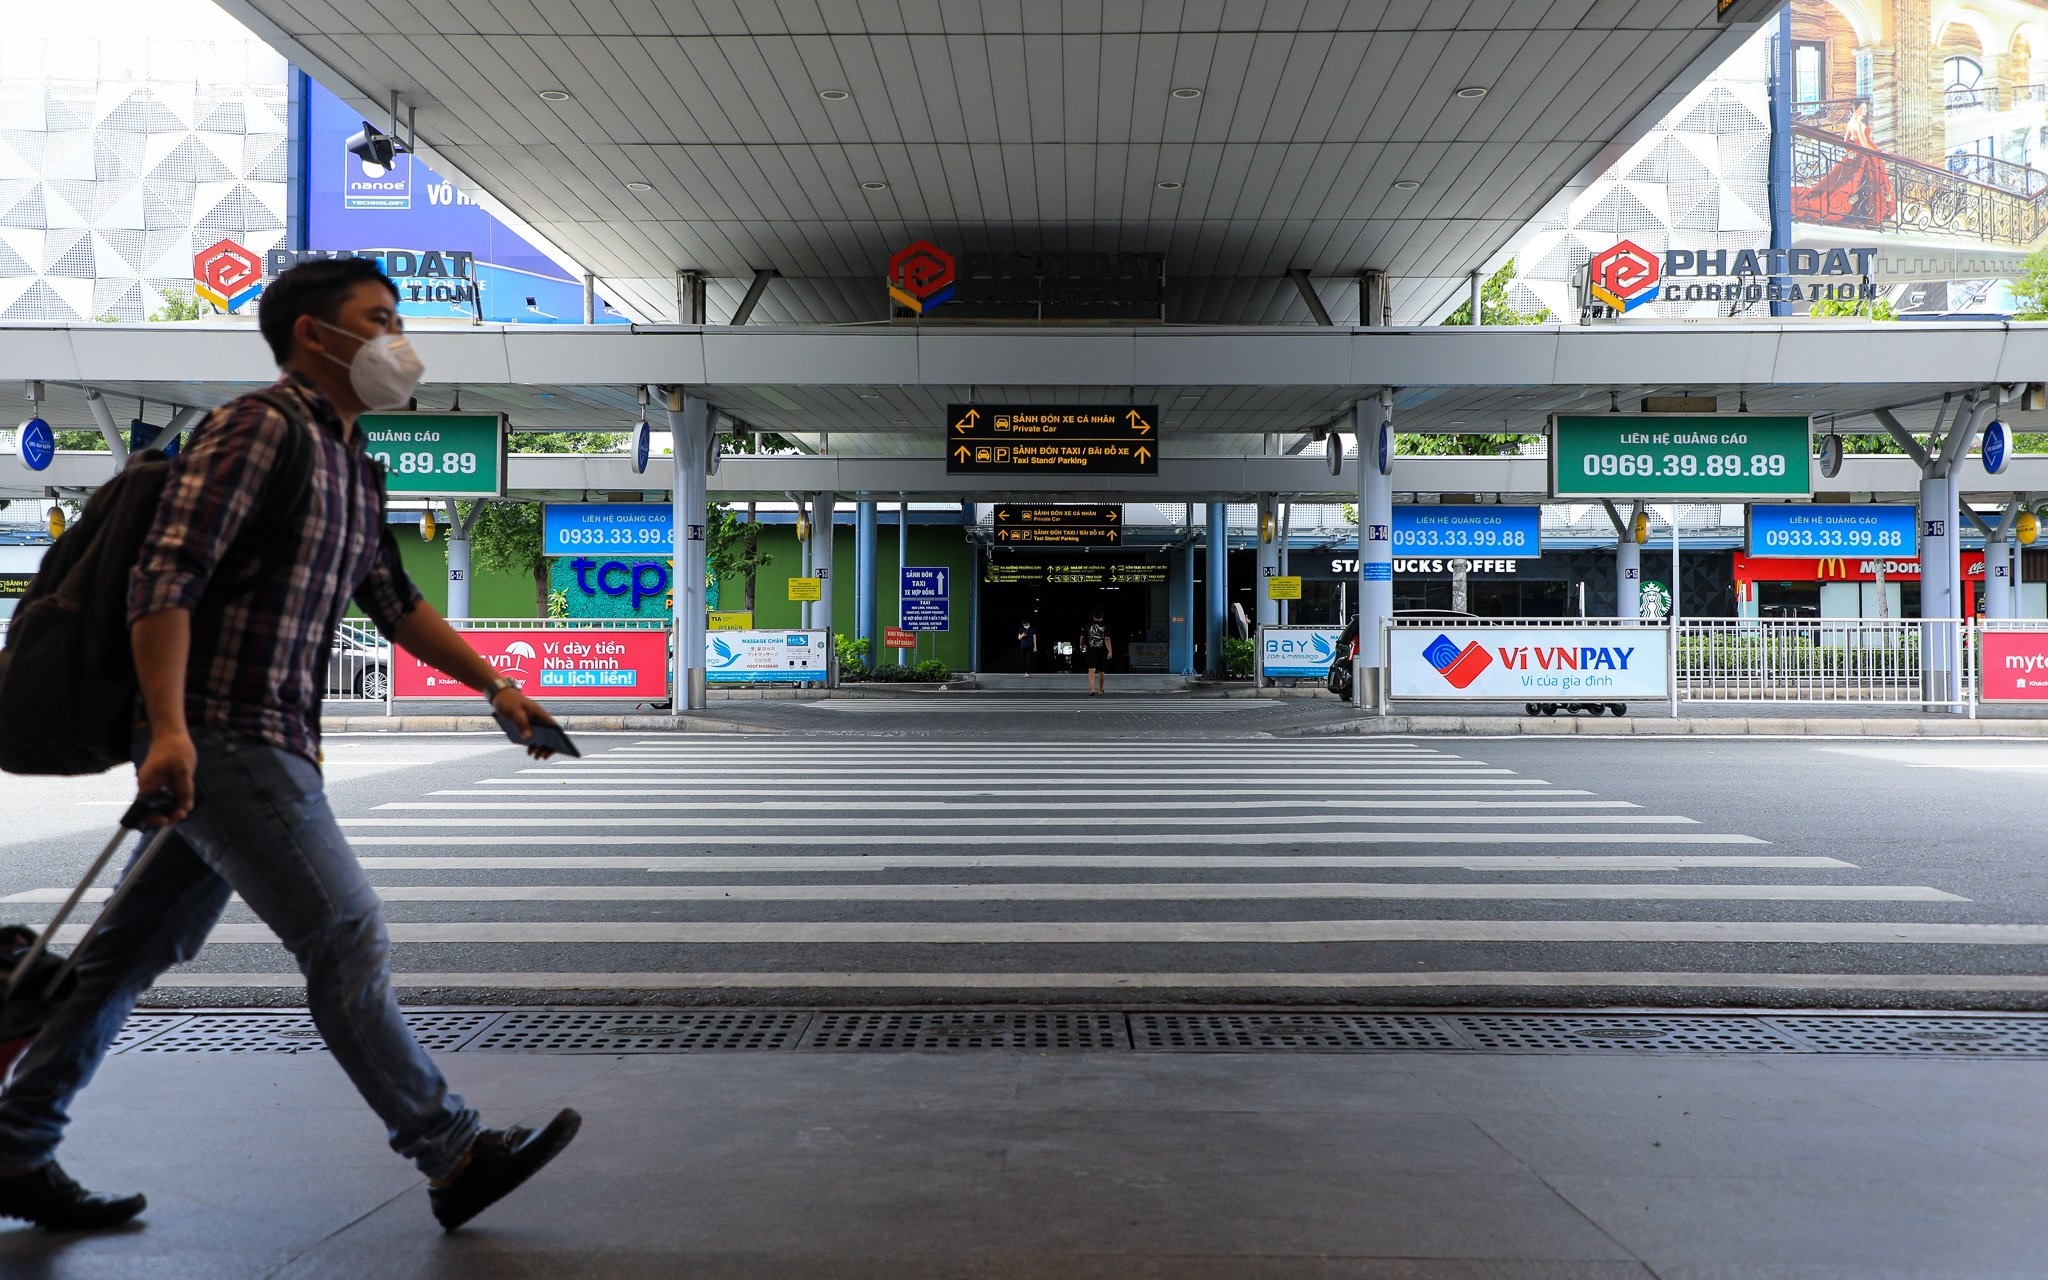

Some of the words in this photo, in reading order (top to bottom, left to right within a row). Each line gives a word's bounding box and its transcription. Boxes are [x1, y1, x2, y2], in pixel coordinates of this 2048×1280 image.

[427, 180, 453, 206] VÔ
[1666, 248, 1878, 276] PHATDAT
[1666, 283, 1877, 302] CORPORATION
[1012, 412, 1038, 423] SẢNH
[1040, 414, 1059, 423] ĐÓN
[1077, 414, 1090, 423] CÁ
[1091, 414, 1115, 423] NHÂN
[368, 429, 412, 442] QUẢNG
[414, 431, 440, 442] CÁO
[1012, 425, 1043, 433] Private
[1044, 425, 1057, 433] Car
[1620, 432, 1649, 444] LIÊN
[1653, 432, 1670, 445] HỆ
[1673, 432, 1718, 444] QUẢNG
[1721, 433, 1748, 444] CÁO
[1012, 445, 1037, 455] SẢNH
[1039, 445, 1058, 455] ĐÓN
[1060, 447, 1081, 455] TAXI
[1088, 445, 1102, 455] BÃI
[1104, 444, 1116, 455] ĐỖ
[363, 452, 476, 474] 9.89.89
[1012, 456, 1029, 464] Taxi
[1031, 456, 1056, 464] Stand/
[1057, 456, 1088, 465] Parking
[1583, 454, 1786, 477] 0969.39.89.89
[582, 514, 601, 523] LIÊN
[603, 514, 614, 523] HỆ
[617, 514, 646, 523] QUẢNG
[648, 514, 666, 523] CÁO
[1416, 515, 1435, 524] LIÊN
[1437, 516, 1449, 524] HỆ
[1451, 515, 1481, 524] QUẢNG
[1483, 516, 1502, 524] CÁO
[1789, 515, 1810, 524] LIÊN
[1811, 515, 1823, 524] HỆ
[1825, 515, 1857, 524] QUẢNG
[1859, 516, 1878, 524] CÁO
[560, 528, 673, 544] 0933.33.99.8
[1369, 526, 1388, 540] B-14
[1923, 522, 1944, 536] B-15
[1393, 530, 1525, 546] 0933.33.99.88
[1766, 530, 1902, 547] 0933.33.99.88
[1331, 559, 1443, 573] STUCKS
[450, 570, 463, 580] C-12
[906, 569, 920, 578] SẢNH
[1625, 569, 1638, 579] C-15
[570, 557, 668, 610] tcp
[911, 589, 922, 597] HỢP
[922, 588, 935, 596] ĐỒNG
[543, 641, 560, 655] Ví
[562, 641, 591, 657] dày
[594, 640, 625, 655] tiền
[543, 656, 575, 670] Nhà
[579, 656, 619, 670] mình
[1498, 646, 1528, 670] Ví
[1534, 647, 1635, 670] VNPAY
[543, 671, 564, 685] du
[568, 671, 597, 687] lịch
[600, 670, 632, 685] liền!
[1521, 675, 1533, 687] Ví
[1537, 675, 1558, 687] của
[1562, 675, 1581, 690] gia
[1585, 675, 1613, 687] đình
